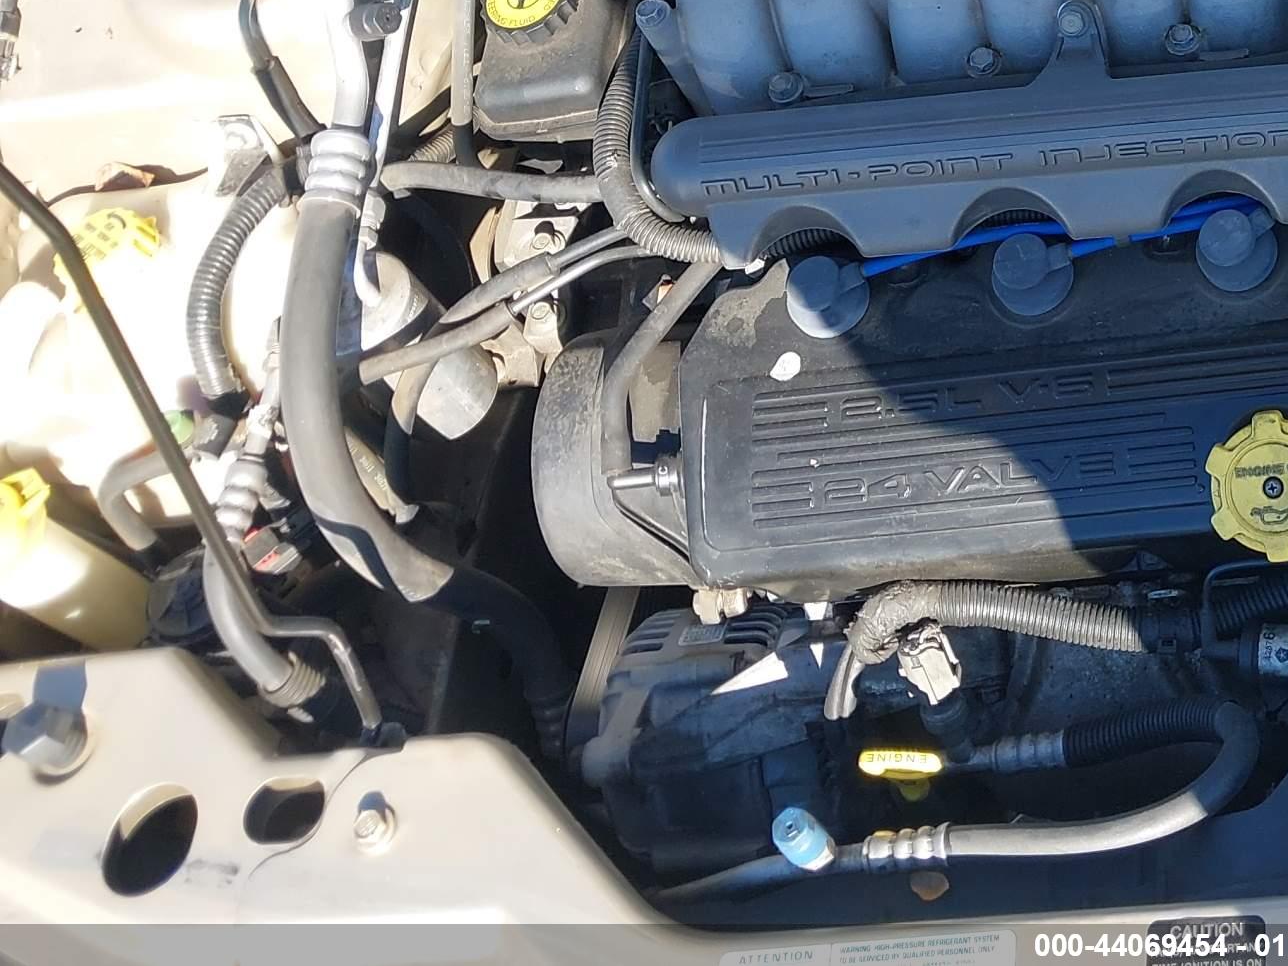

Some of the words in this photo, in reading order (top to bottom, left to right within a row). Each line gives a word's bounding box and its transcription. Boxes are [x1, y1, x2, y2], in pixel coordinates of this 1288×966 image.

[1235, 463, 1285, 478] ENGINE
[823, 472, 912, 506] 24
[922, 451, 1117, 496] VALVE
[866, 754, 927, 763] ENGINE
[1170, 922, 1243, 939] CAUTION
[739, 951, 814, 965] ATTENTION
